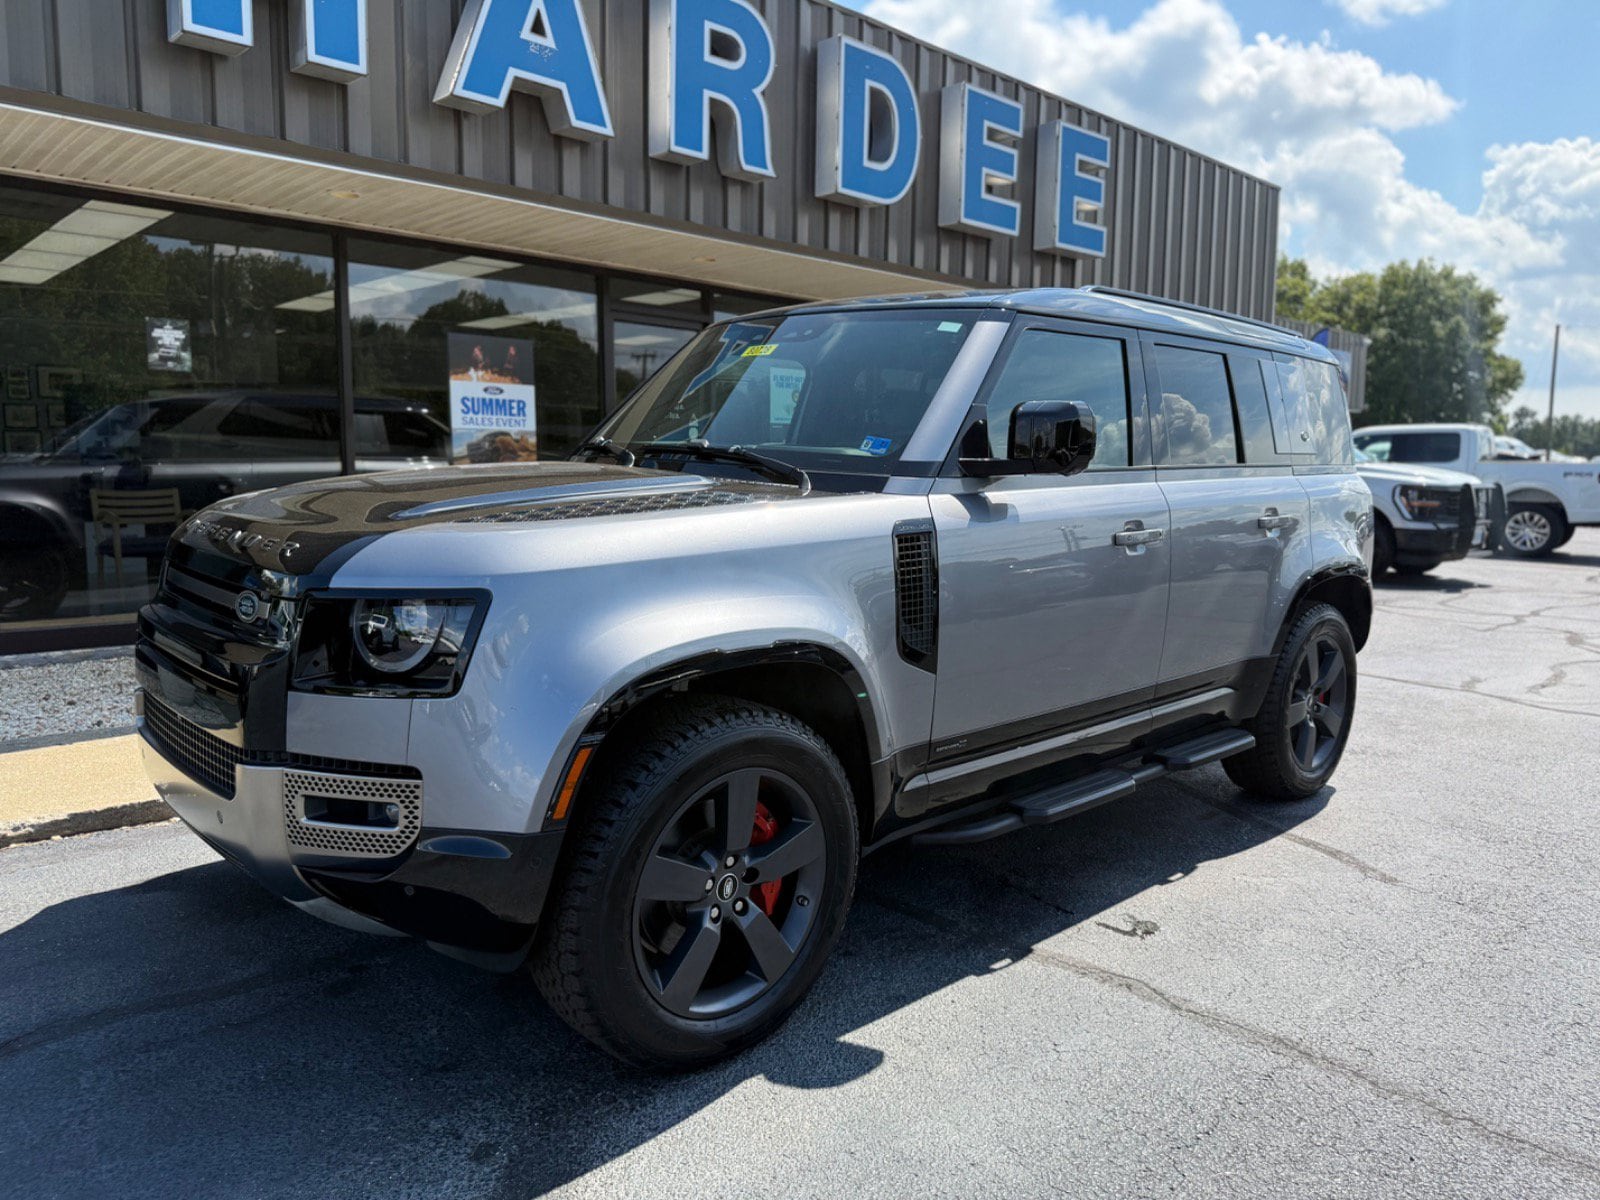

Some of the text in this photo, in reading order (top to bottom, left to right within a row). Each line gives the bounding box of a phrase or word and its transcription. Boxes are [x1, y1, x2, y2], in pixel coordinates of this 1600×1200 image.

[167, 0, 1111, 258] ARDEE
[461, 396, 527, 417] SUMMER
[462, 417, 527, 428] SALES EVENT
